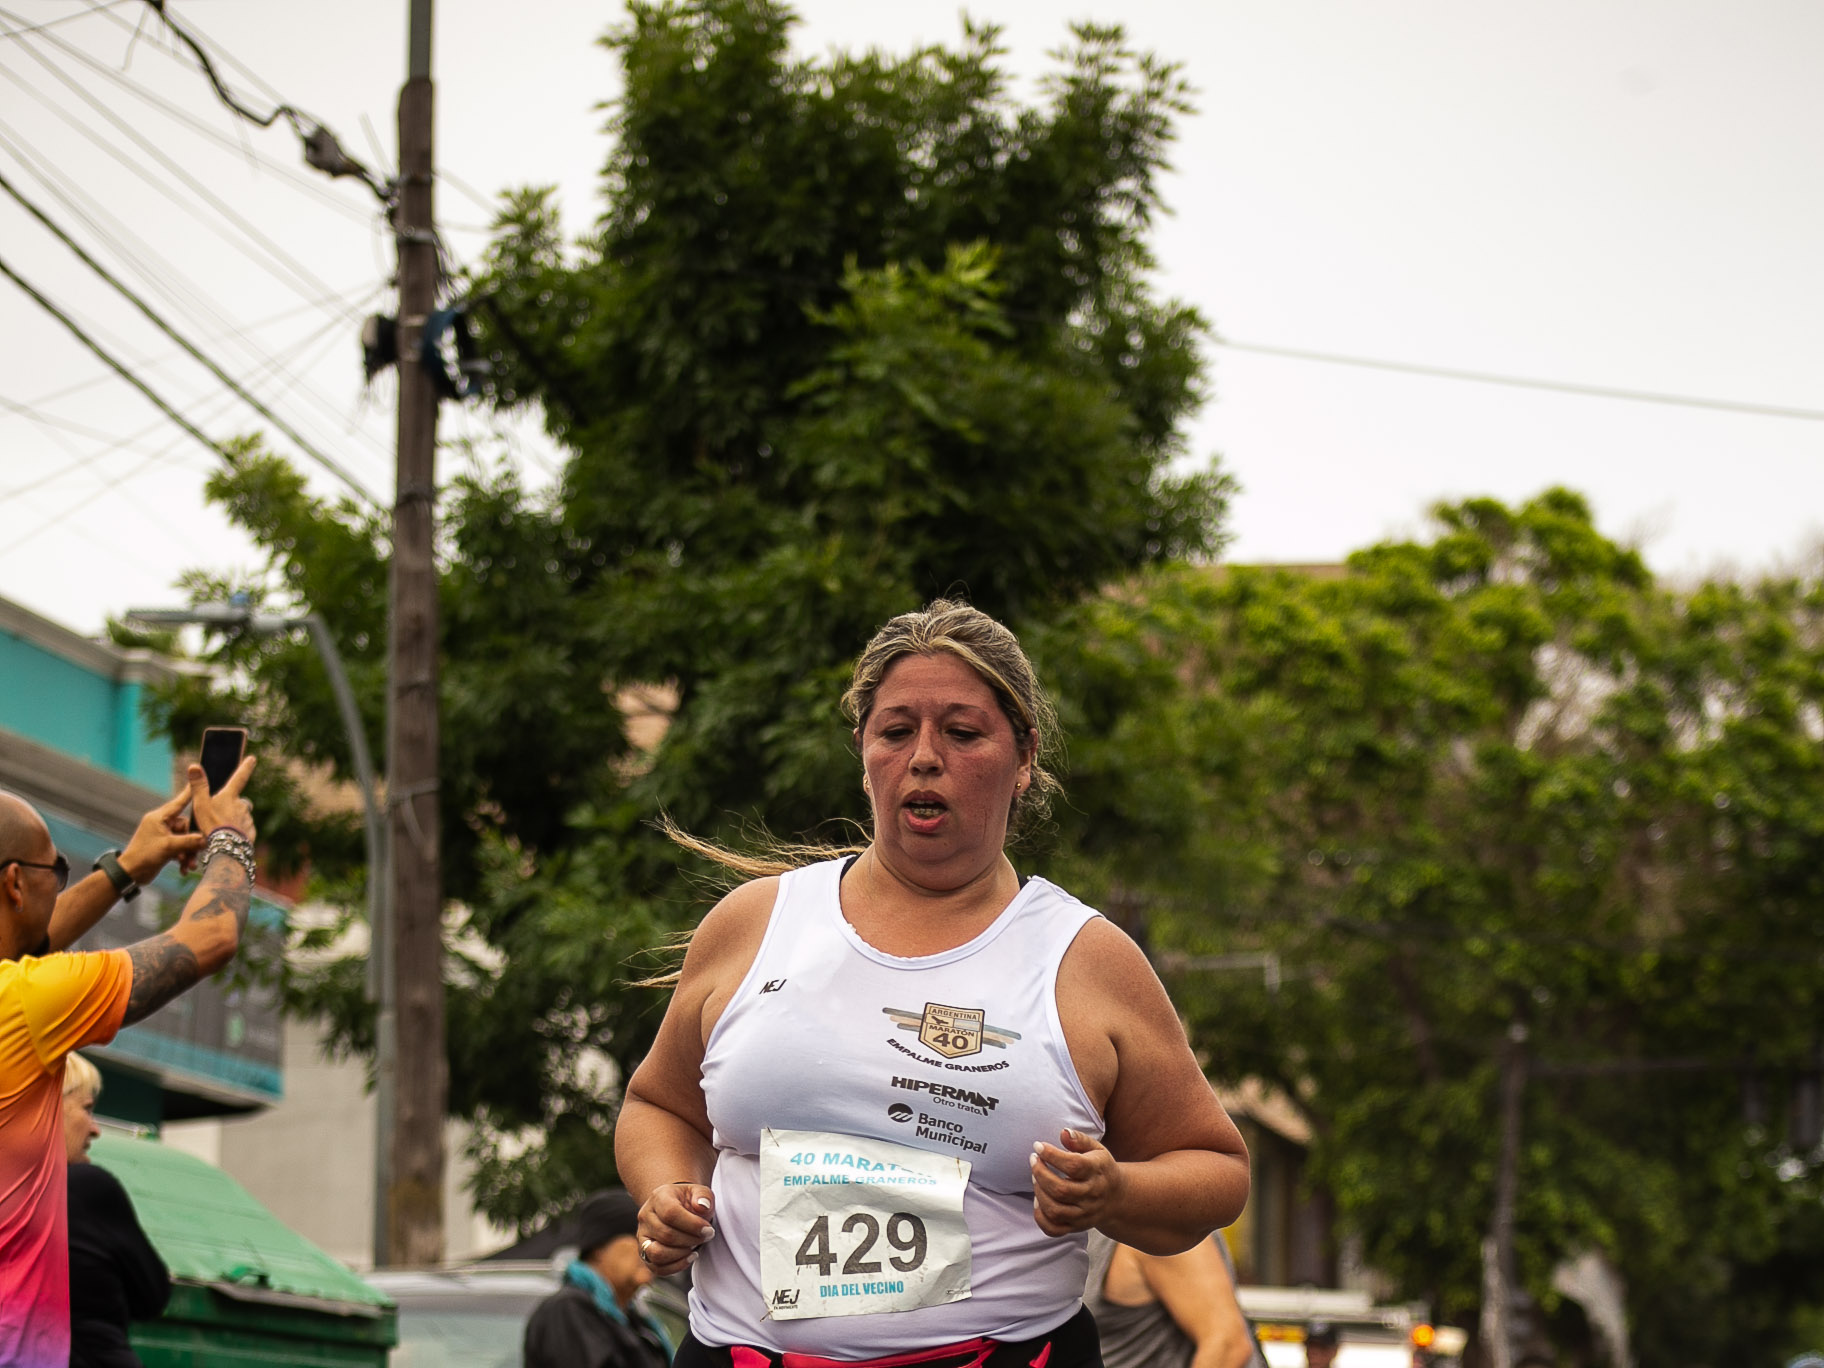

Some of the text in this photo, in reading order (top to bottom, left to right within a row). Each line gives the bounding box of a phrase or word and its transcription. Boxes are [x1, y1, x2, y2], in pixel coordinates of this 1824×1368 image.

[931, 1008, 977, 1020] ARGENTINA
[928, 1024, 975, 1038] MARATÓN
[932, 1032, 969, 1050] 40
[886, 1038, 1010, 1073] EMPALME GRANEROS
[932, 1096, 956, 1108] Otro
[918, 1112, 964, 1134] Banco
[915, 1125, 988, 1155] Municipal
[789, 1152, 816, 1166] 40
[783, 1174, 937, 1187] EMPALME GRANEROS
[794, 1211, 928, 1277] 429
[771, 1288, 801, 1305] NEJ
[819, 1281, 905, 1298] DIA DEL VECINO
